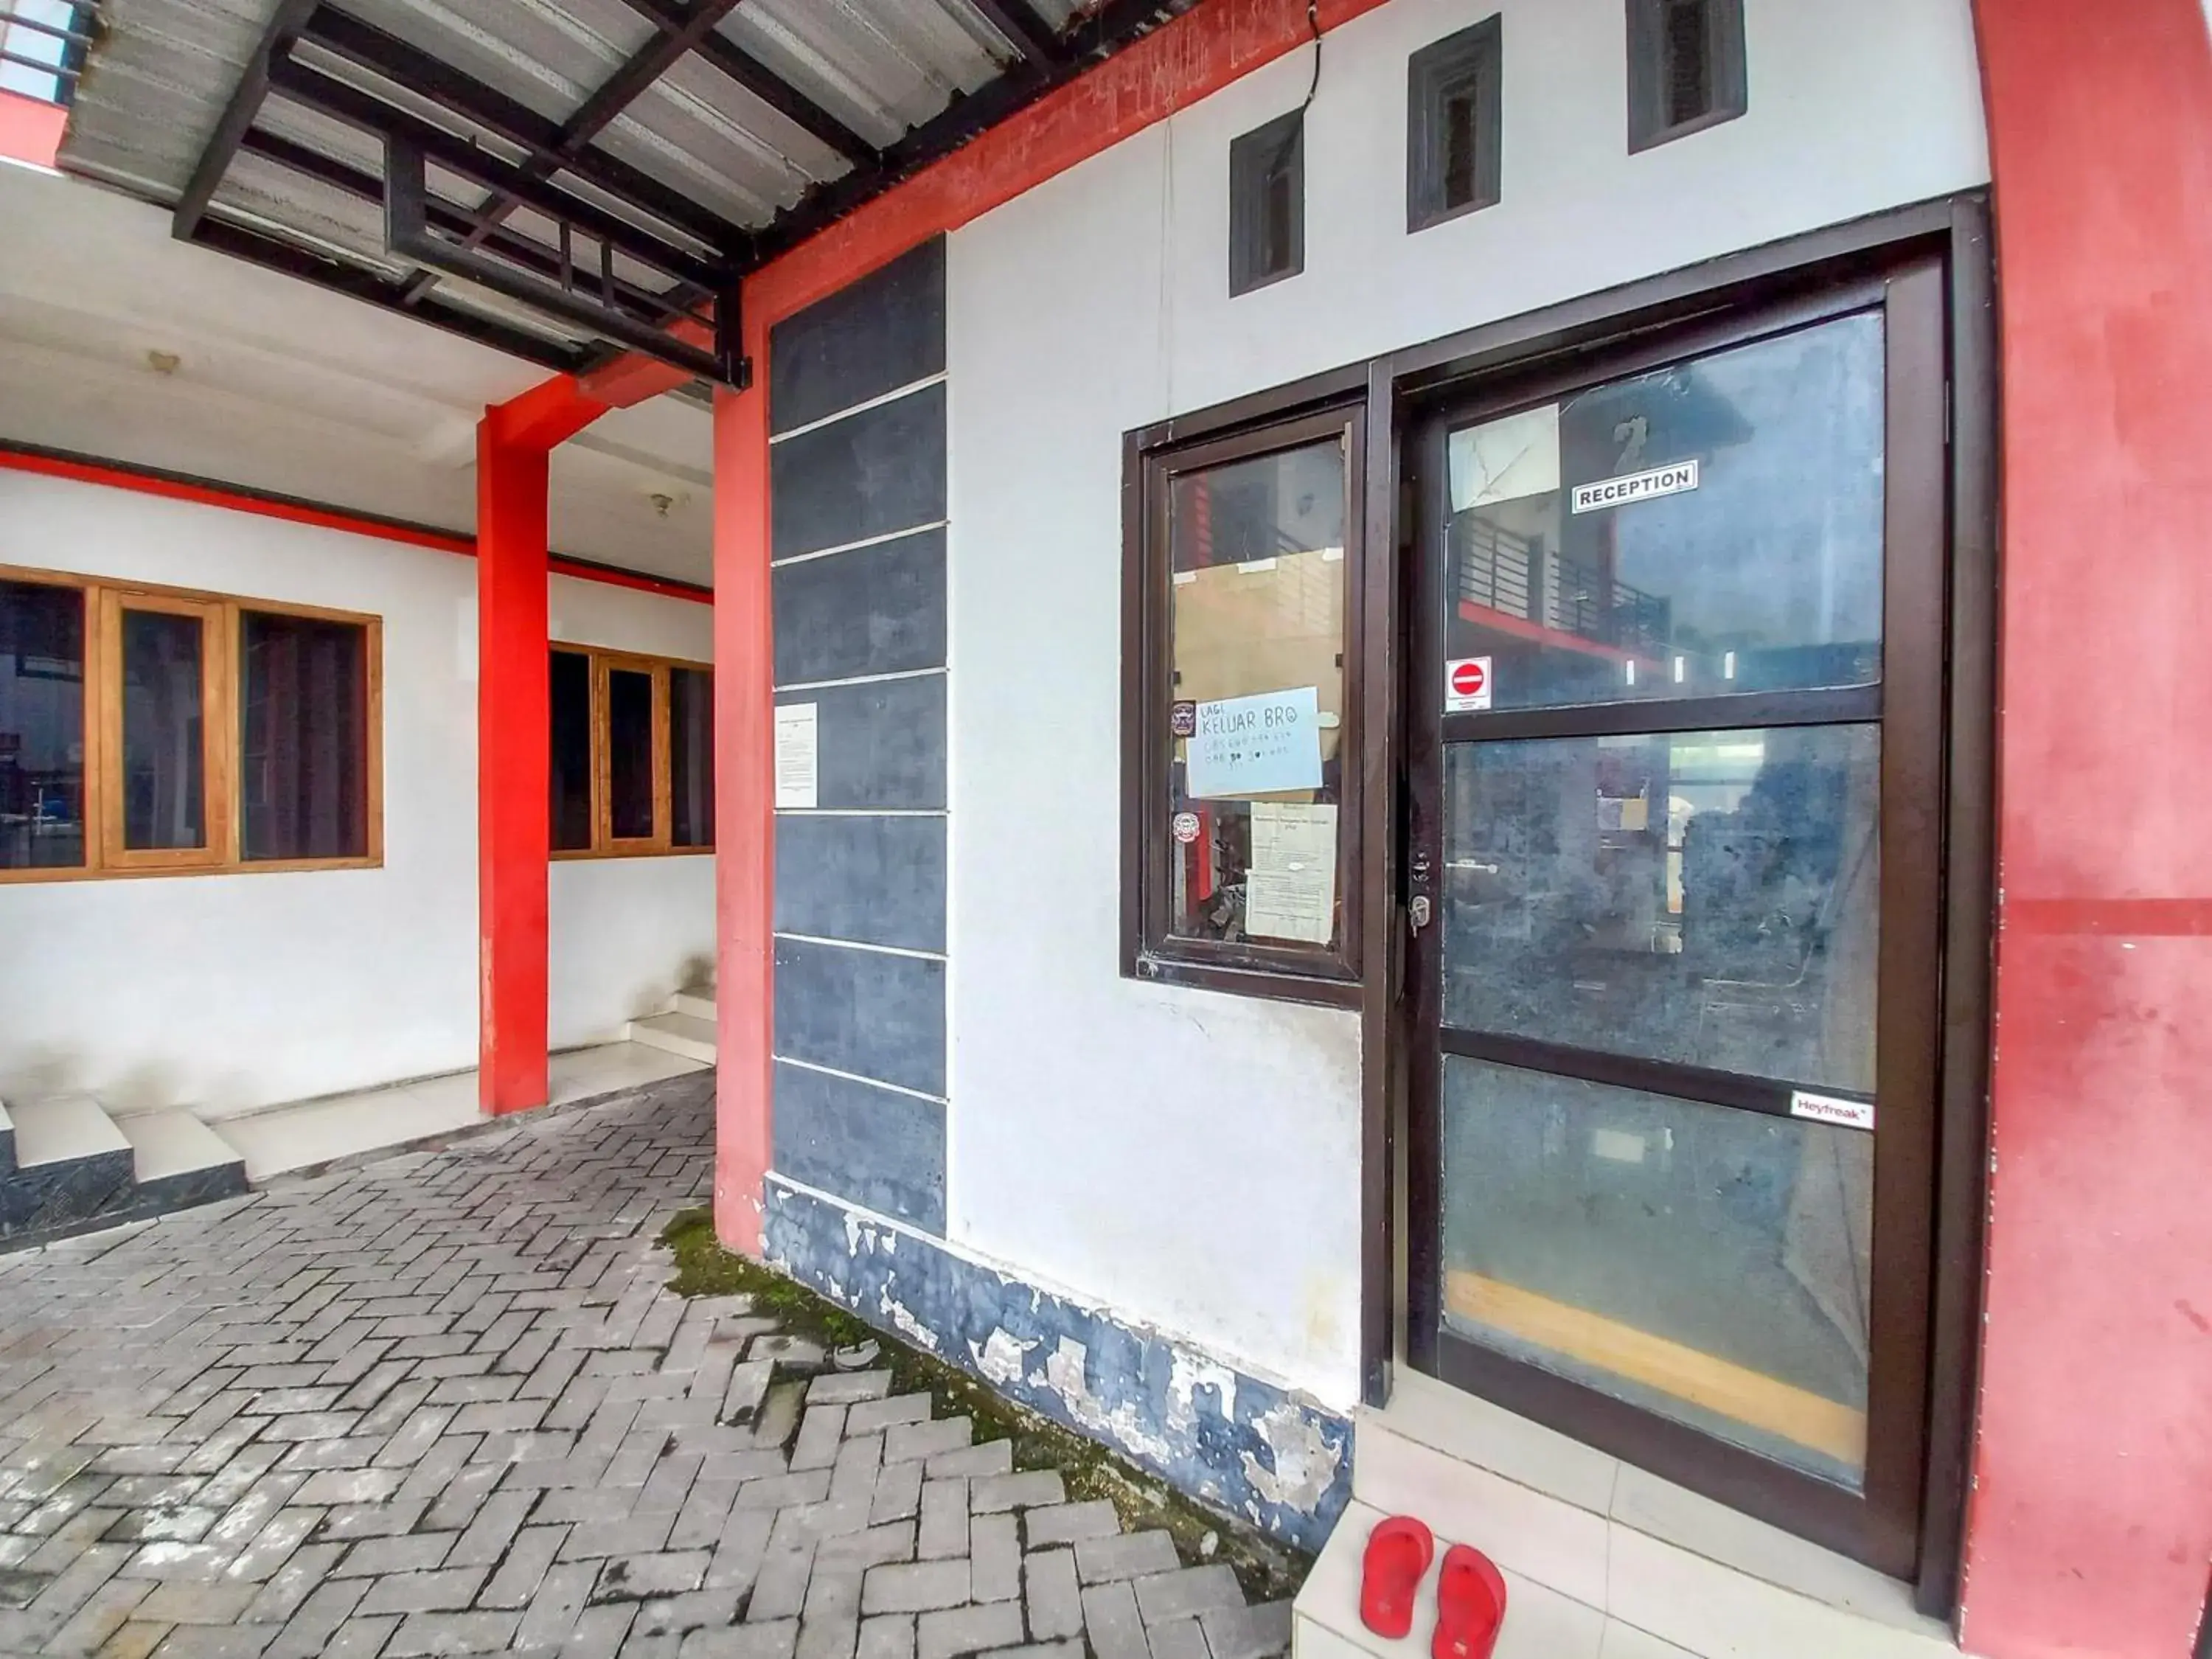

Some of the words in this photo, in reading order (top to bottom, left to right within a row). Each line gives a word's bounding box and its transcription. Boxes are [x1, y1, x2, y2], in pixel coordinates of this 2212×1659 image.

[1580, 470, 1688, 505] RECEPTION
[1203, 711, 1256, 734] KELUAR
[1265, 706, 1298, 728] BRO
[1798, 1099, 1860, 1120] Heyfreak
